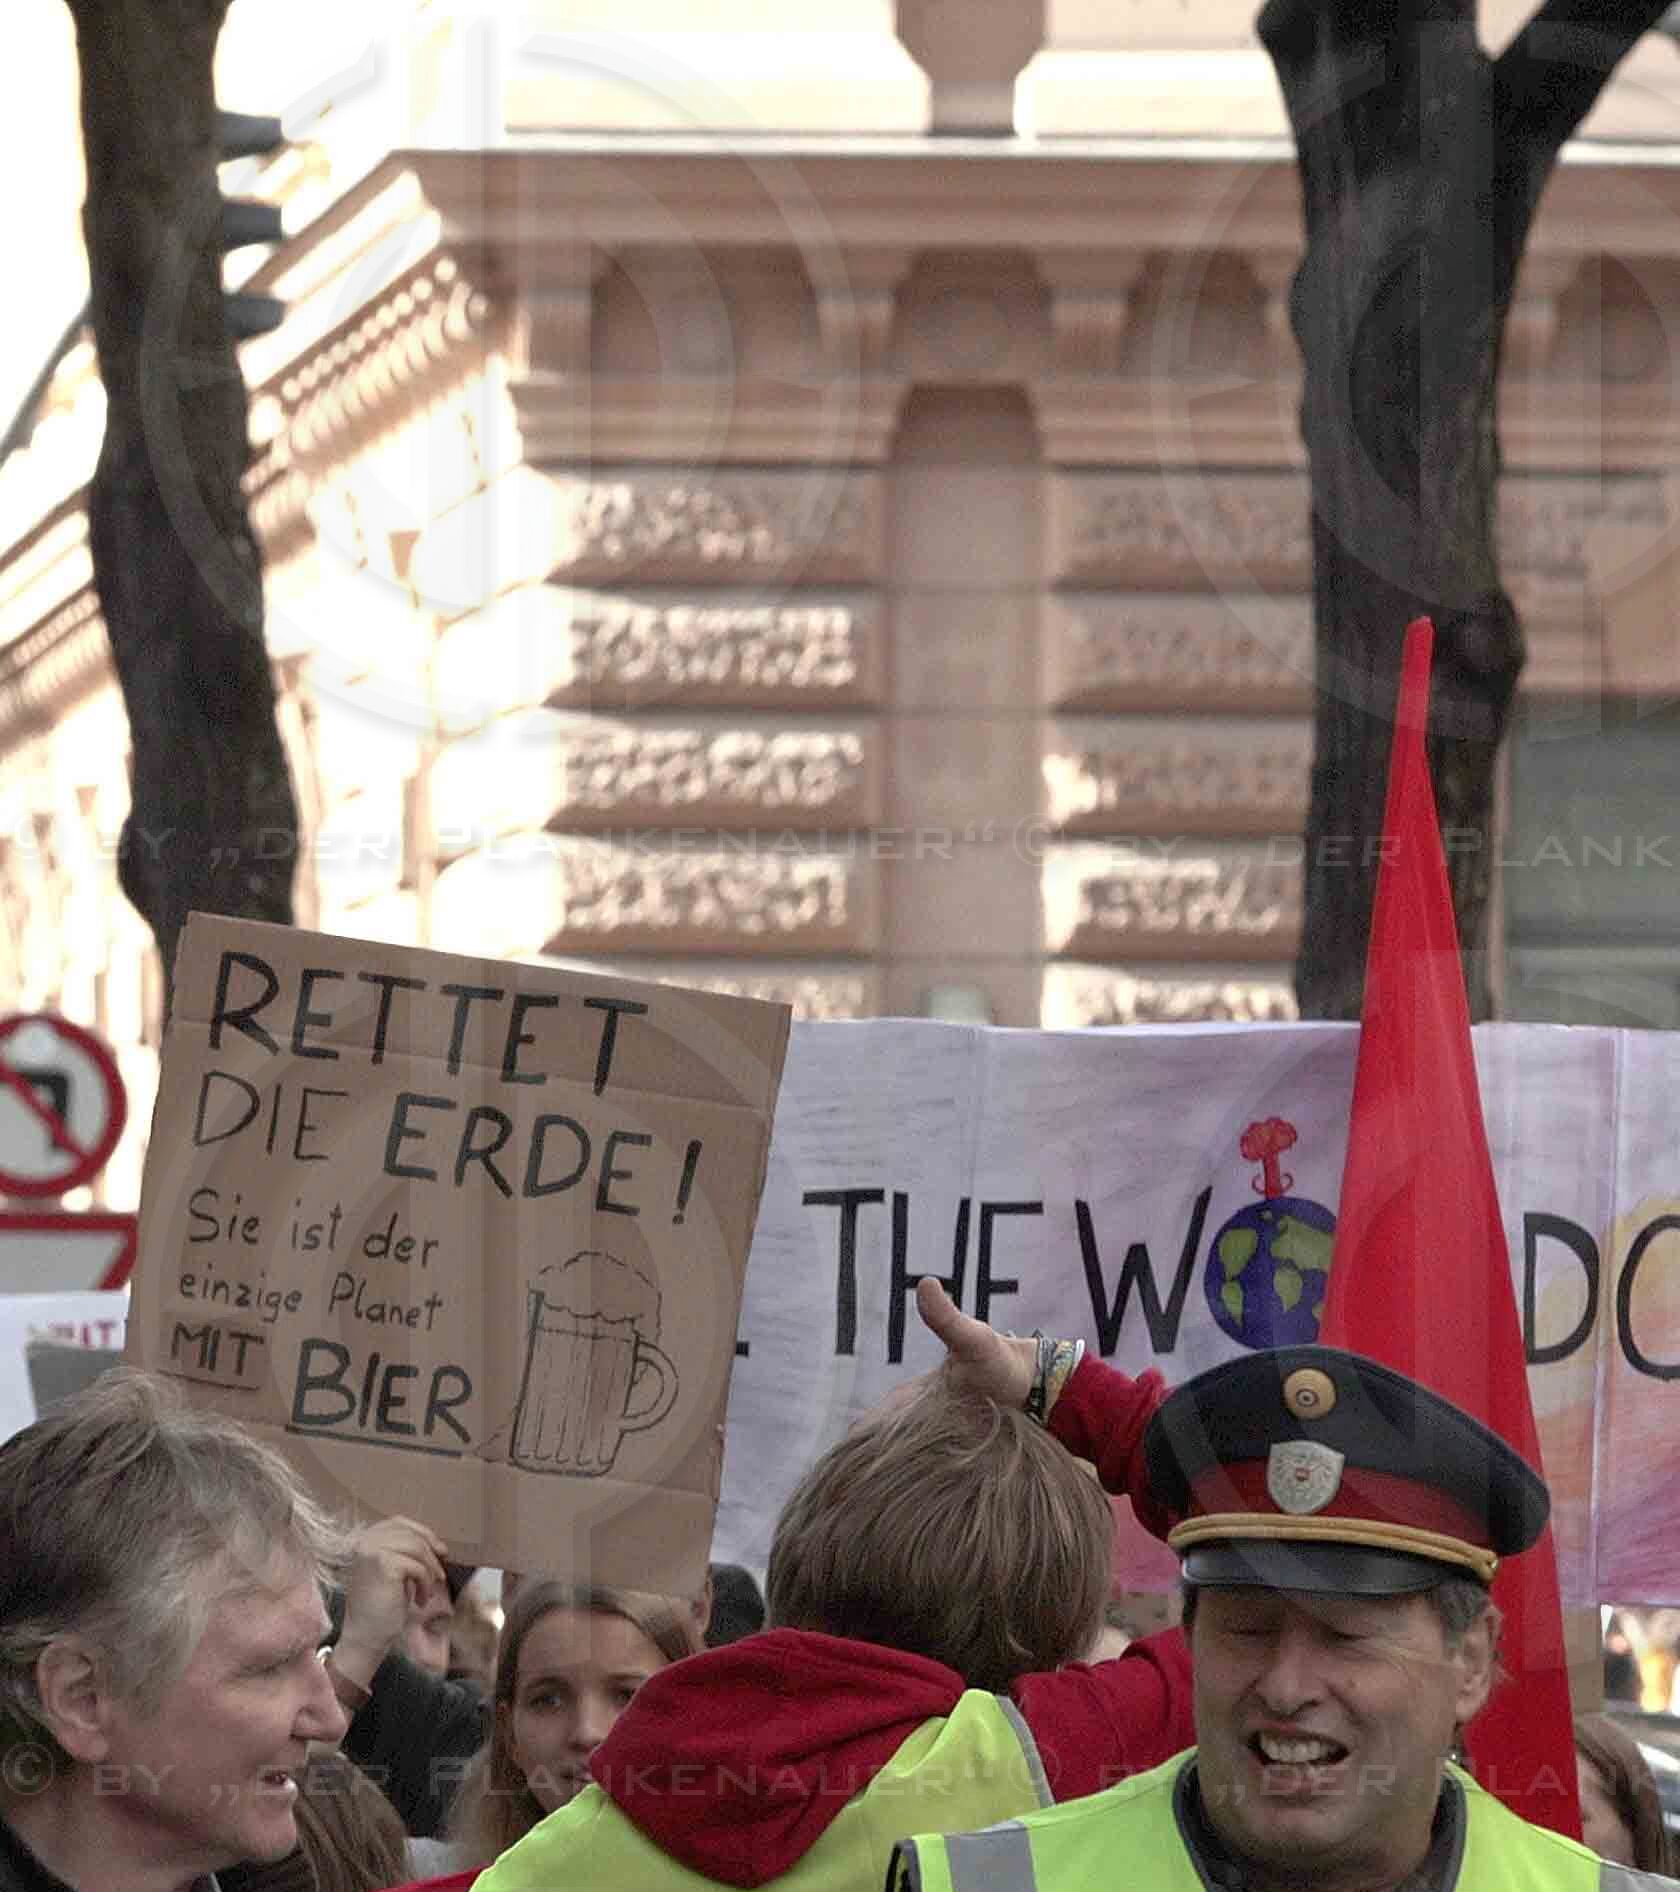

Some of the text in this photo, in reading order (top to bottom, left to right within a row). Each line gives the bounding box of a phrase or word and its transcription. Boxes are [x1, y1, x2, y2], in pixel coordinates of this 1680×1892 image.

[208, 951, 650, 1097] RETTET
[192, 1070, 704, 1226] DIE ERDE!
[187, 1188, 440, 1269] Sie ist der
[801, 1187, 1044, 1365] THE
[178, 1271, 444, 1333] einzige Planet
[171, 1323, 473, 1447] MIT BIER
